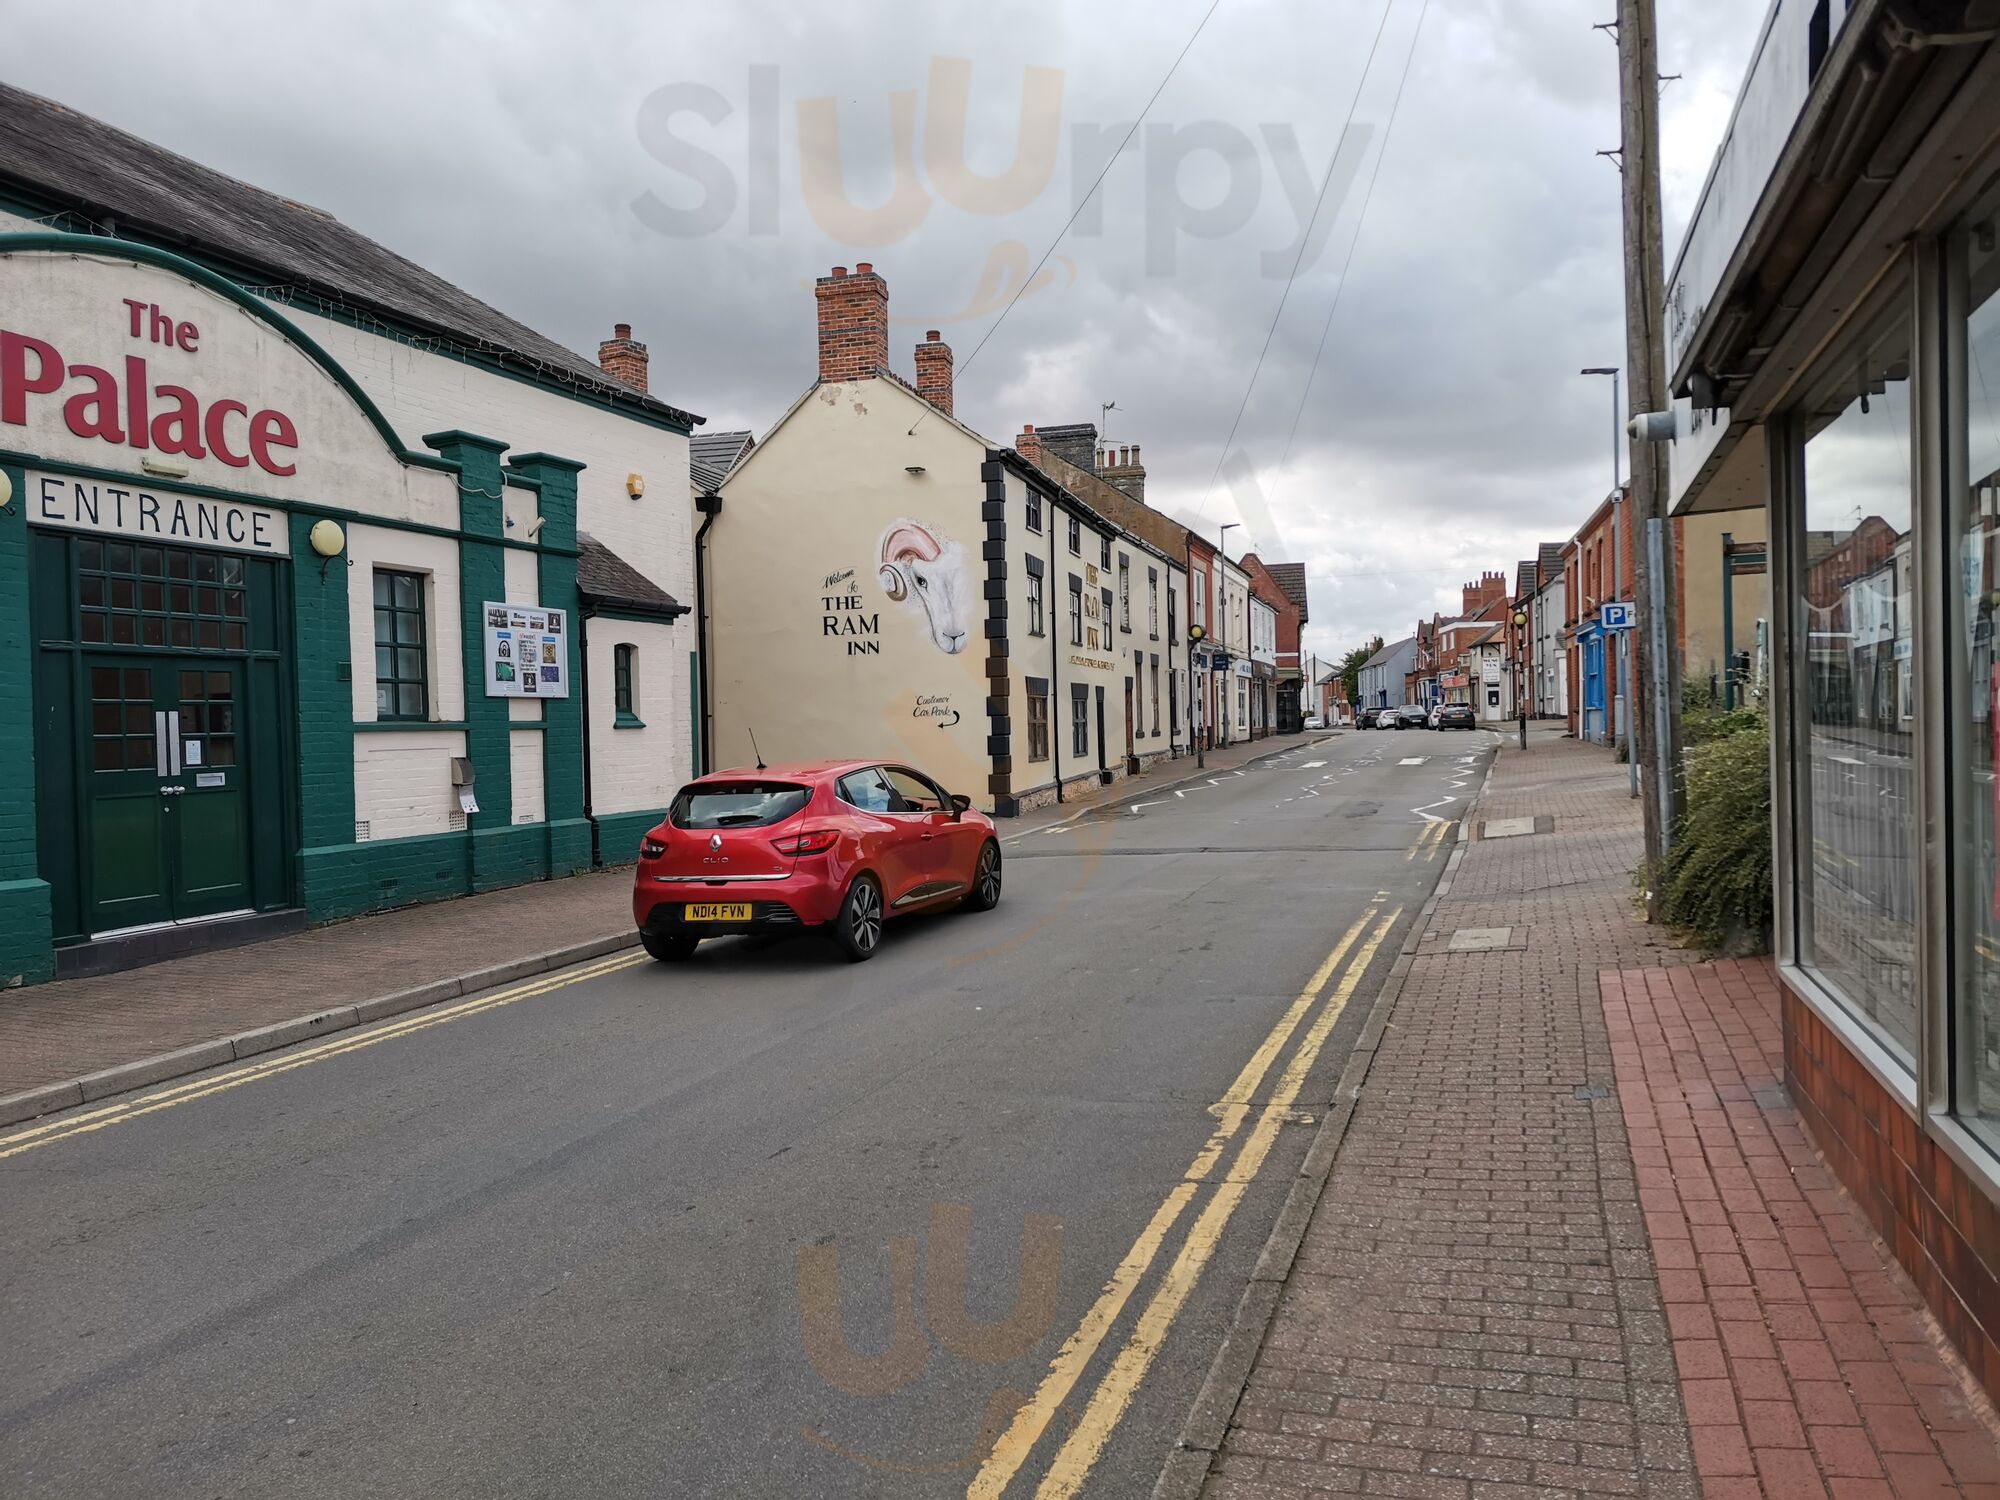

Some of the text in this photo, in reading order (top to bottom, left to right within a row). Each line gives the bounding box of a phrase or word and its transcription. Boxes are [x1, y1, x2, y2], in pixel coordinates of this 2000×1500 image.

[123, 298, 200, 353] The
[0, 330, 298, 477] Palace
[40, 477, 272, 547] ENTRANCE
[823, 568, 854, 588] Welcome
[821, 595, 863, 611] THE
[1609, 608, 1623, 623] P
[823, 613, 879, 636] RAM
[848, 641, 879, 656] INN
[916, 694, 950, 706] Customer
[913, 705, 952, 718] Car Park
[692, 905, 745, 918] ND14 FVN
